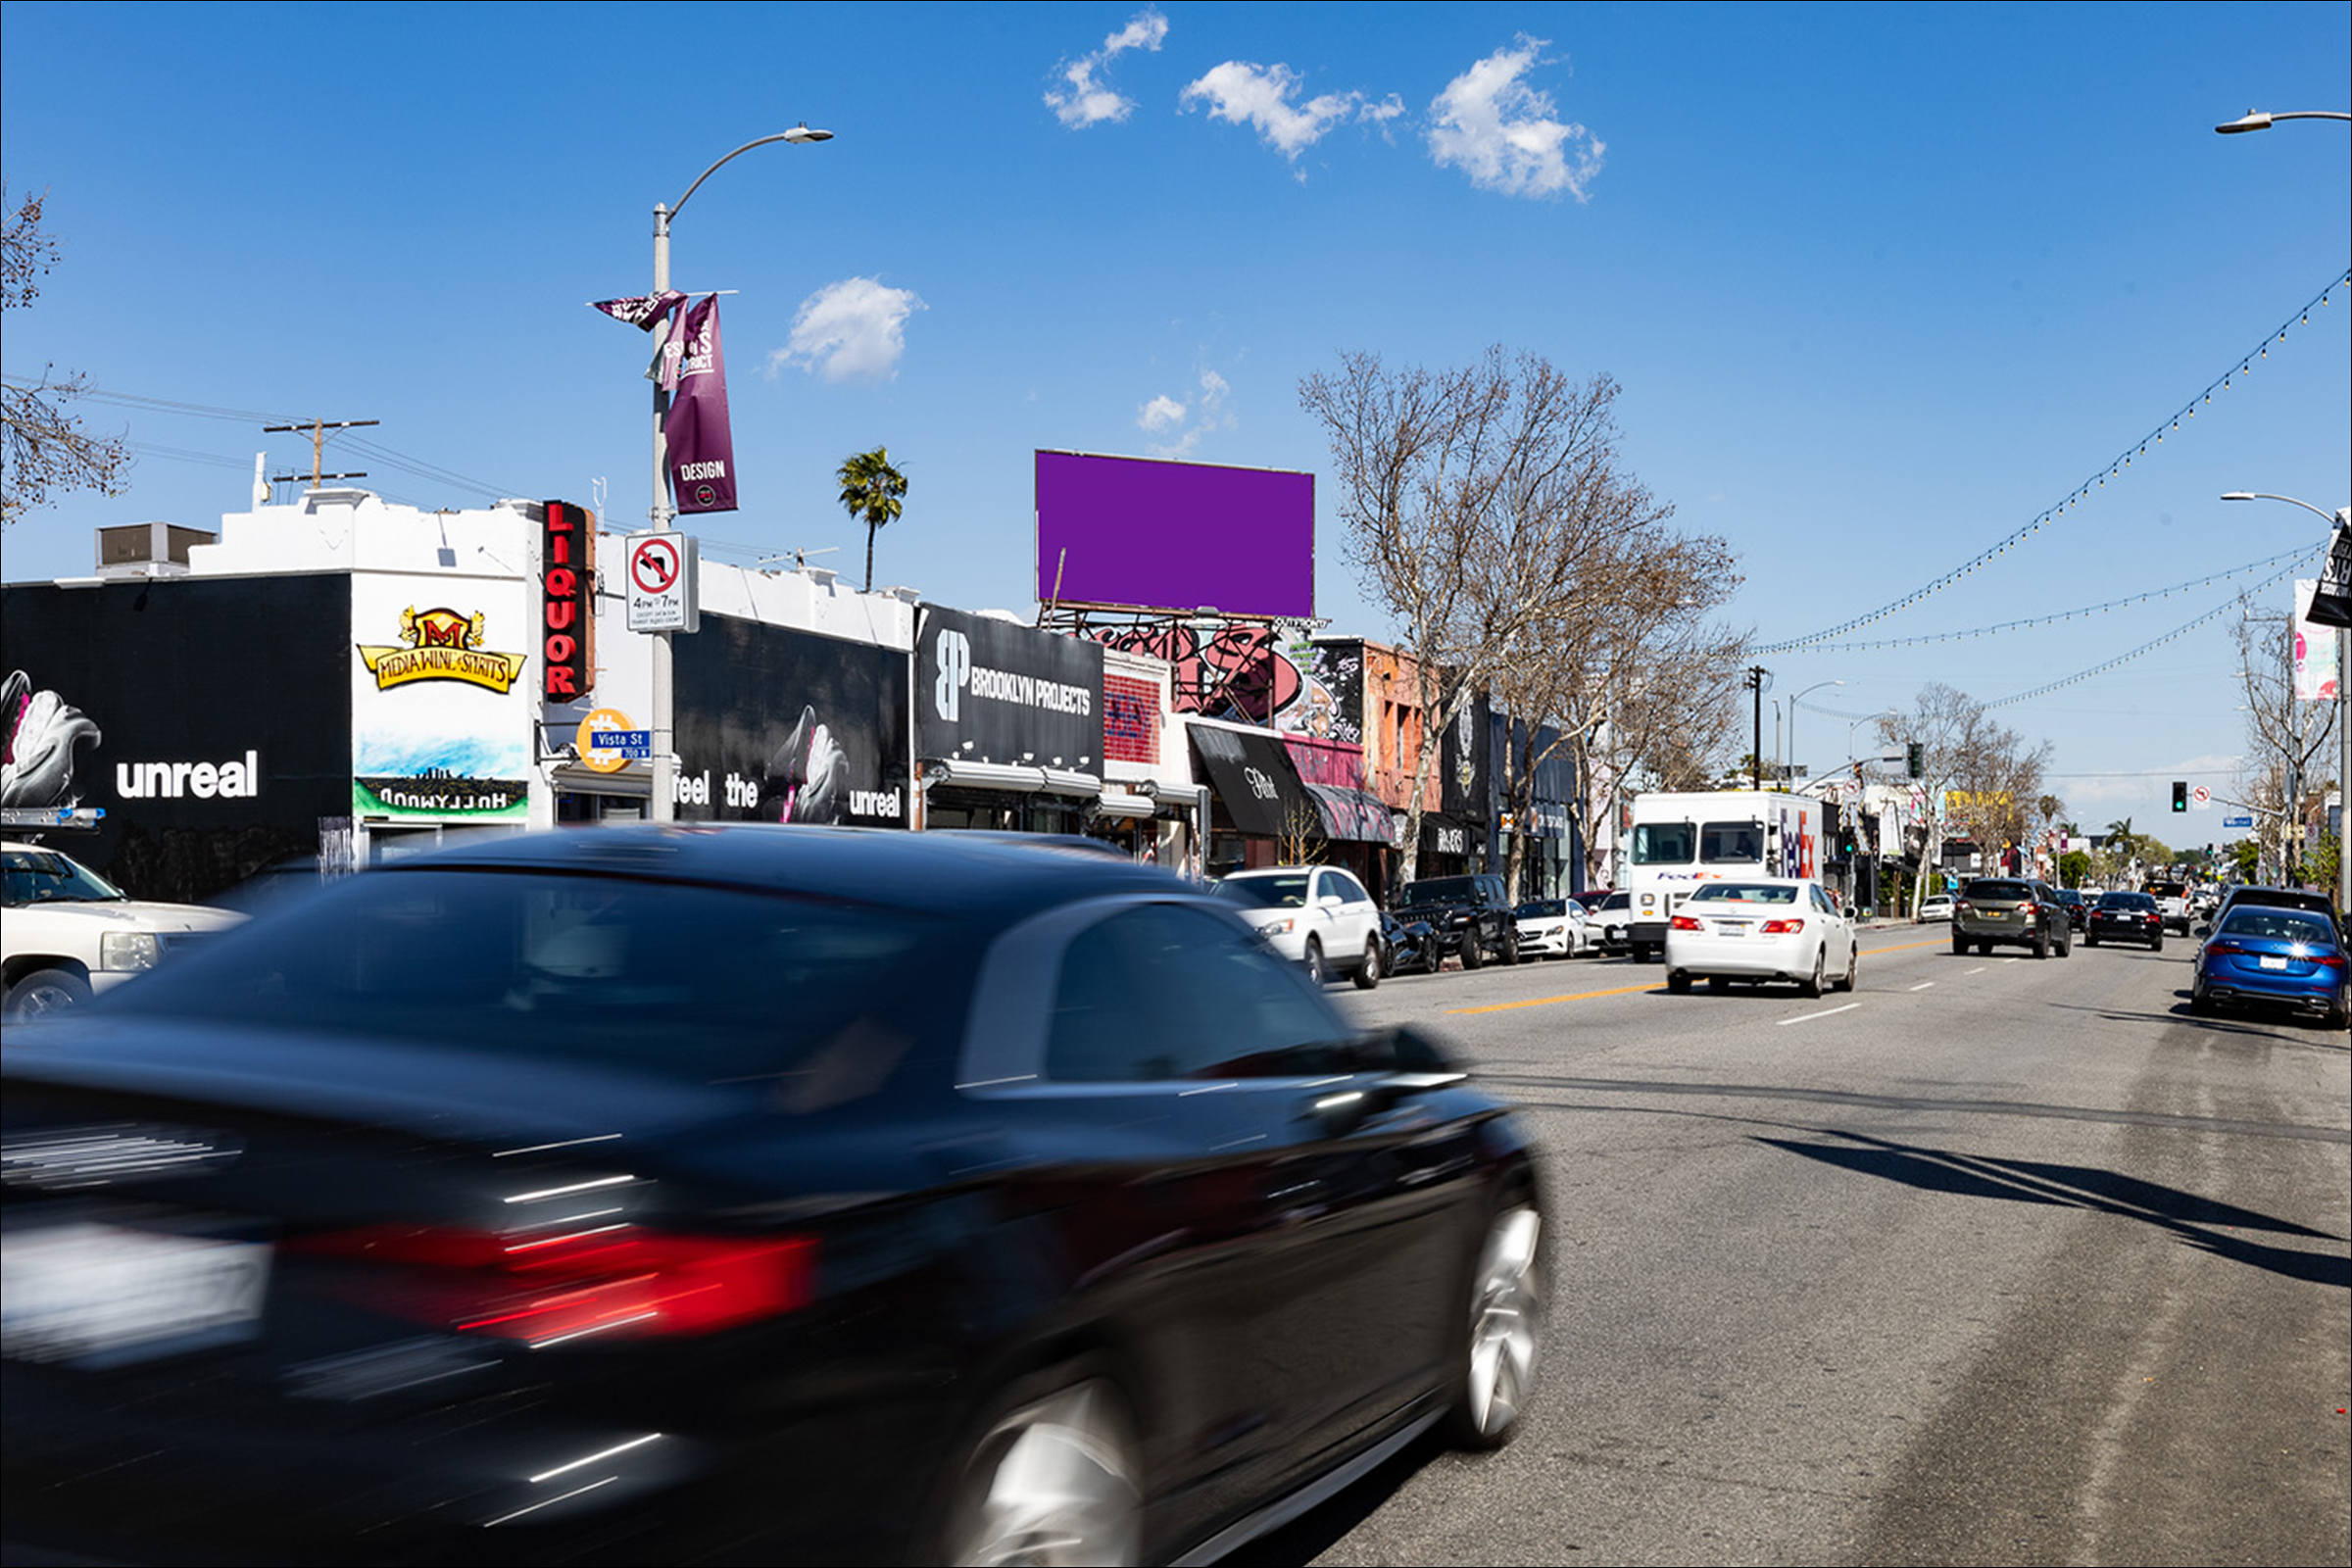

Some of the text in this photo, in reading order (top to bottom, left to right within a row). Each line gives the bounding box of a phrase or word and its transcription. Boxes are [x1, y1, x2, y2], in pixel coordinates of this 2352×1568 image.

[680, 460, 725, 482] DESIGN
[545, 504, 577, 694] LIQUOR
[422, 620, 464, 647] M
[380, 654, 421, 679] MEDIA
[419, 650, 458, 670] WINE
[462, 653, 508, 683] SPIRITS
[970, 665, 1092, 716] BROOKLYN PROJECTS
[597, 733, 643, 746] Vista St
[116, 749, 259, 799] unreal
[725, 772, 759, 808] the
[849, 786, 901, 817] unreal
[1780, 808, 1816, 880] FedEx
[1657, 871, 1724, 881] FedEx
